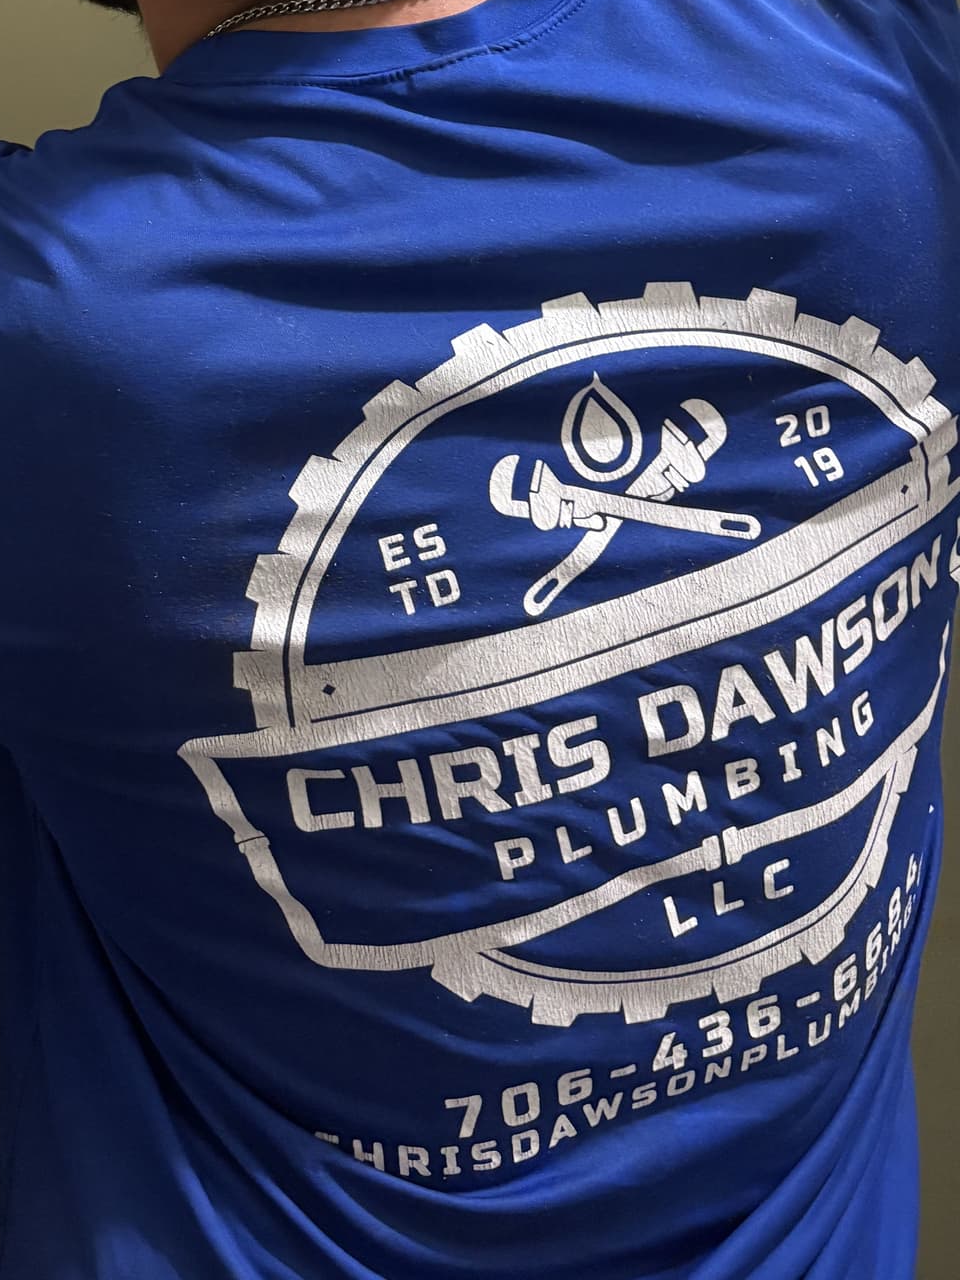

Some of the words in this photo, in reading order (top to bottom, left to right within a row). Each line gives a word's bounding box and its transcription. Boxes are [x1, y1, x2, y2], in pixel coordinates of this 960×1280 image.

[775, 404, 832, 447] 20
[793, 447, 844, 488] 19
[379, 524, 448, 572] ES
[389, 570, 461, 616] TD
[286, 714, 614, 835] CHRIS
[637, 535, 942, 762] DAWSON
[494, 691, 876, 881] PLUMBING
[666, 859, 795, 938] LLC
[314, 850, 924, 1180] HRISDAWSONPLUMBING.
